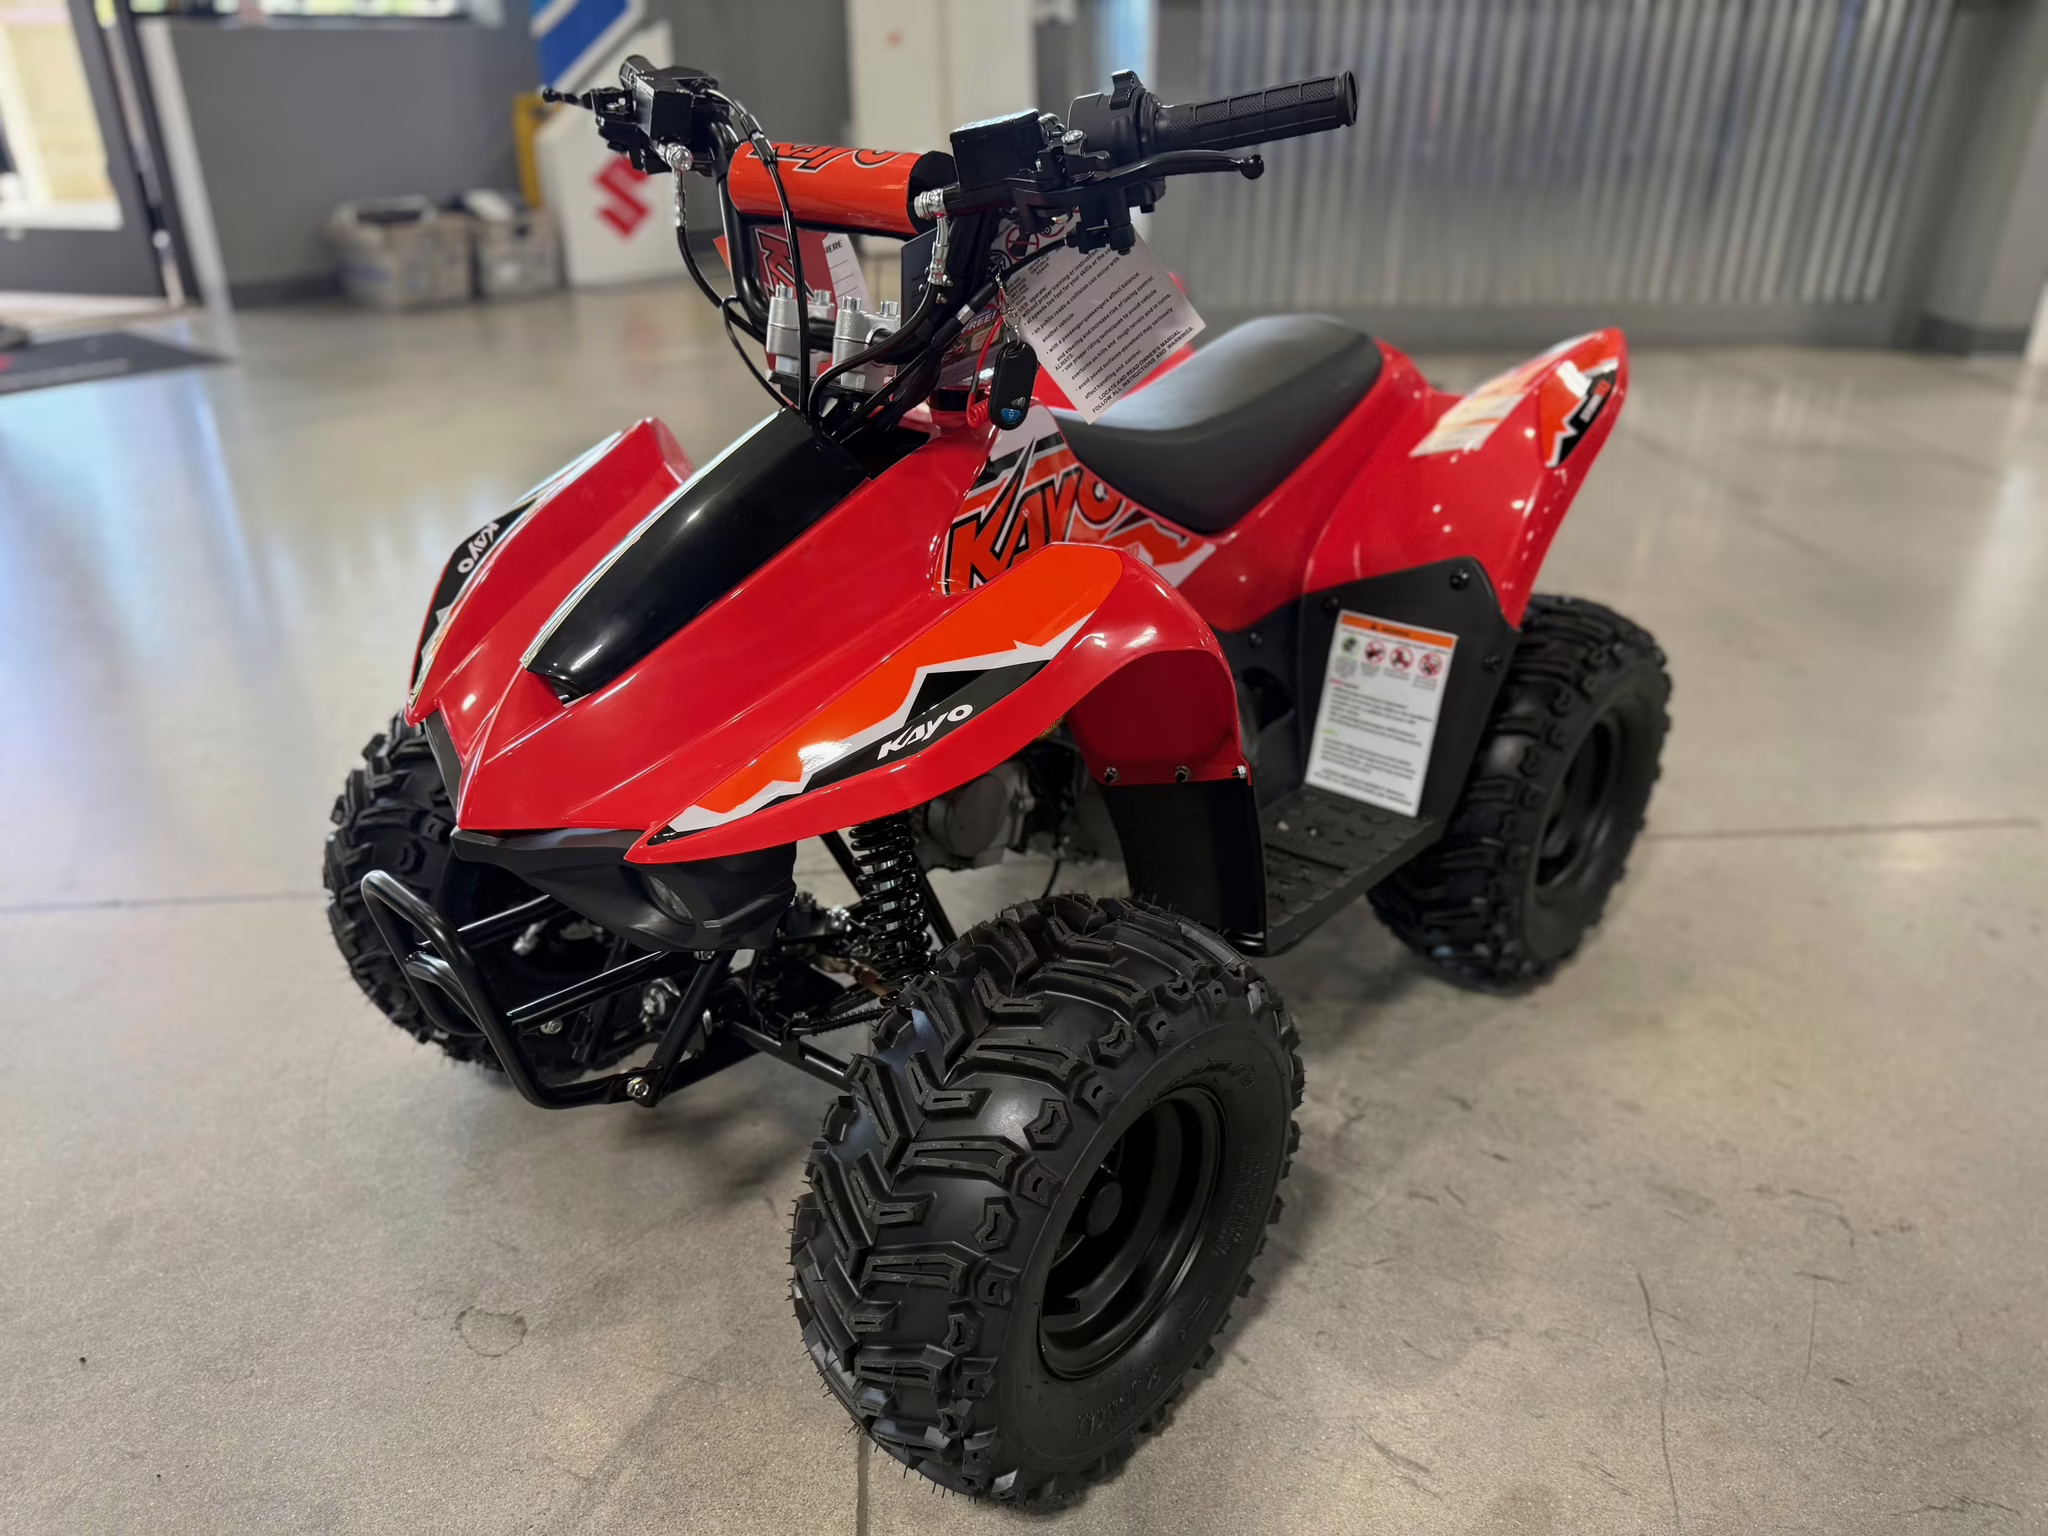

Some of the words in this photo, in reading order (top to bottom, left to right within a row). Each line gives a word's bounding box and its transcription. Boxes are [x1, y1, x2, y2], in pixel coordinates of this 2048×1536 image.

[1031, 304, 1047, 320] speeds
[1045, 297, 1055, 306] too
[1053, 289, 1063, 299] fast
[1061, 283, 1069, 291] for
[1068, 274, 1080, 286] your
[1079, 264, 1092, 276] skills
[1096, 253, 1105, 261] the
[1037, 289, 1052, 304] proper
[1051, 274, 1070, 290] training
[1039, 314, 1054, 329] public
[1069, 283, 1089, 301] collision
[1087, 276, 1097, 285] can
[1096, 264, 1109, 278] occur
[1109, 256, 1119, 266] with
[1048, 342, 1059, 352] with
[1108, 286, 1122, 299] affect
[1120, 272, 1139, 288] balance
[1042, 326, 1058, 342] another
[1056, 351, 1065, 361] and
[1064, 337, 1083, 356] steering
[1082, 329, 1091, 339] and
[1089, 313, 1109, 331] increase
[1108, 306, 1118, 315] risk
[1117, 300, 1123, 308] of
[1122, 289, 1138, 303] losing
[1064, 361, 1073, 370] use
[1072, 349, 1087, 364] proper
[1086, 338, 1100, 351] riding
[1098, 317, 1123, 339] techniques
[1128, 301, 1141, 315] avoid
[1140, 289, 1156, 304] vehicle
[1071, 361, 1092, 380] overturns
[1096, 347, 1108, 357] hills
[1106, 339, 1116, 349] and
[1116, 327, 1130, 340] rough
[1128, 315, 1144, 329] terrain
[1144, 307, 1153, 317] and
[1077, 377, 1090, 390] avoid
[1089, 366, 1103, 380] paved
[1142, 324, 1152, 334] may
[1151, 307, 1172, 326] seriously
[1084, 386, 1097, 399] affect
[1096, 371, 1116, 388] handling
[1115, 363, 1124, 373] and
[1092, 394, 1112, 413] FOLLOW
[1112, 387, 1122, 396] ALL
[1121, 357, 1155, 387] INSTRUCTIONS
[1155, 347, 1166, 359] AND
[1098, 382, 1118, 400] LOCATE
[1116, 374, 1127, 385] AND
[1125, 363, 1139, 376] READ
